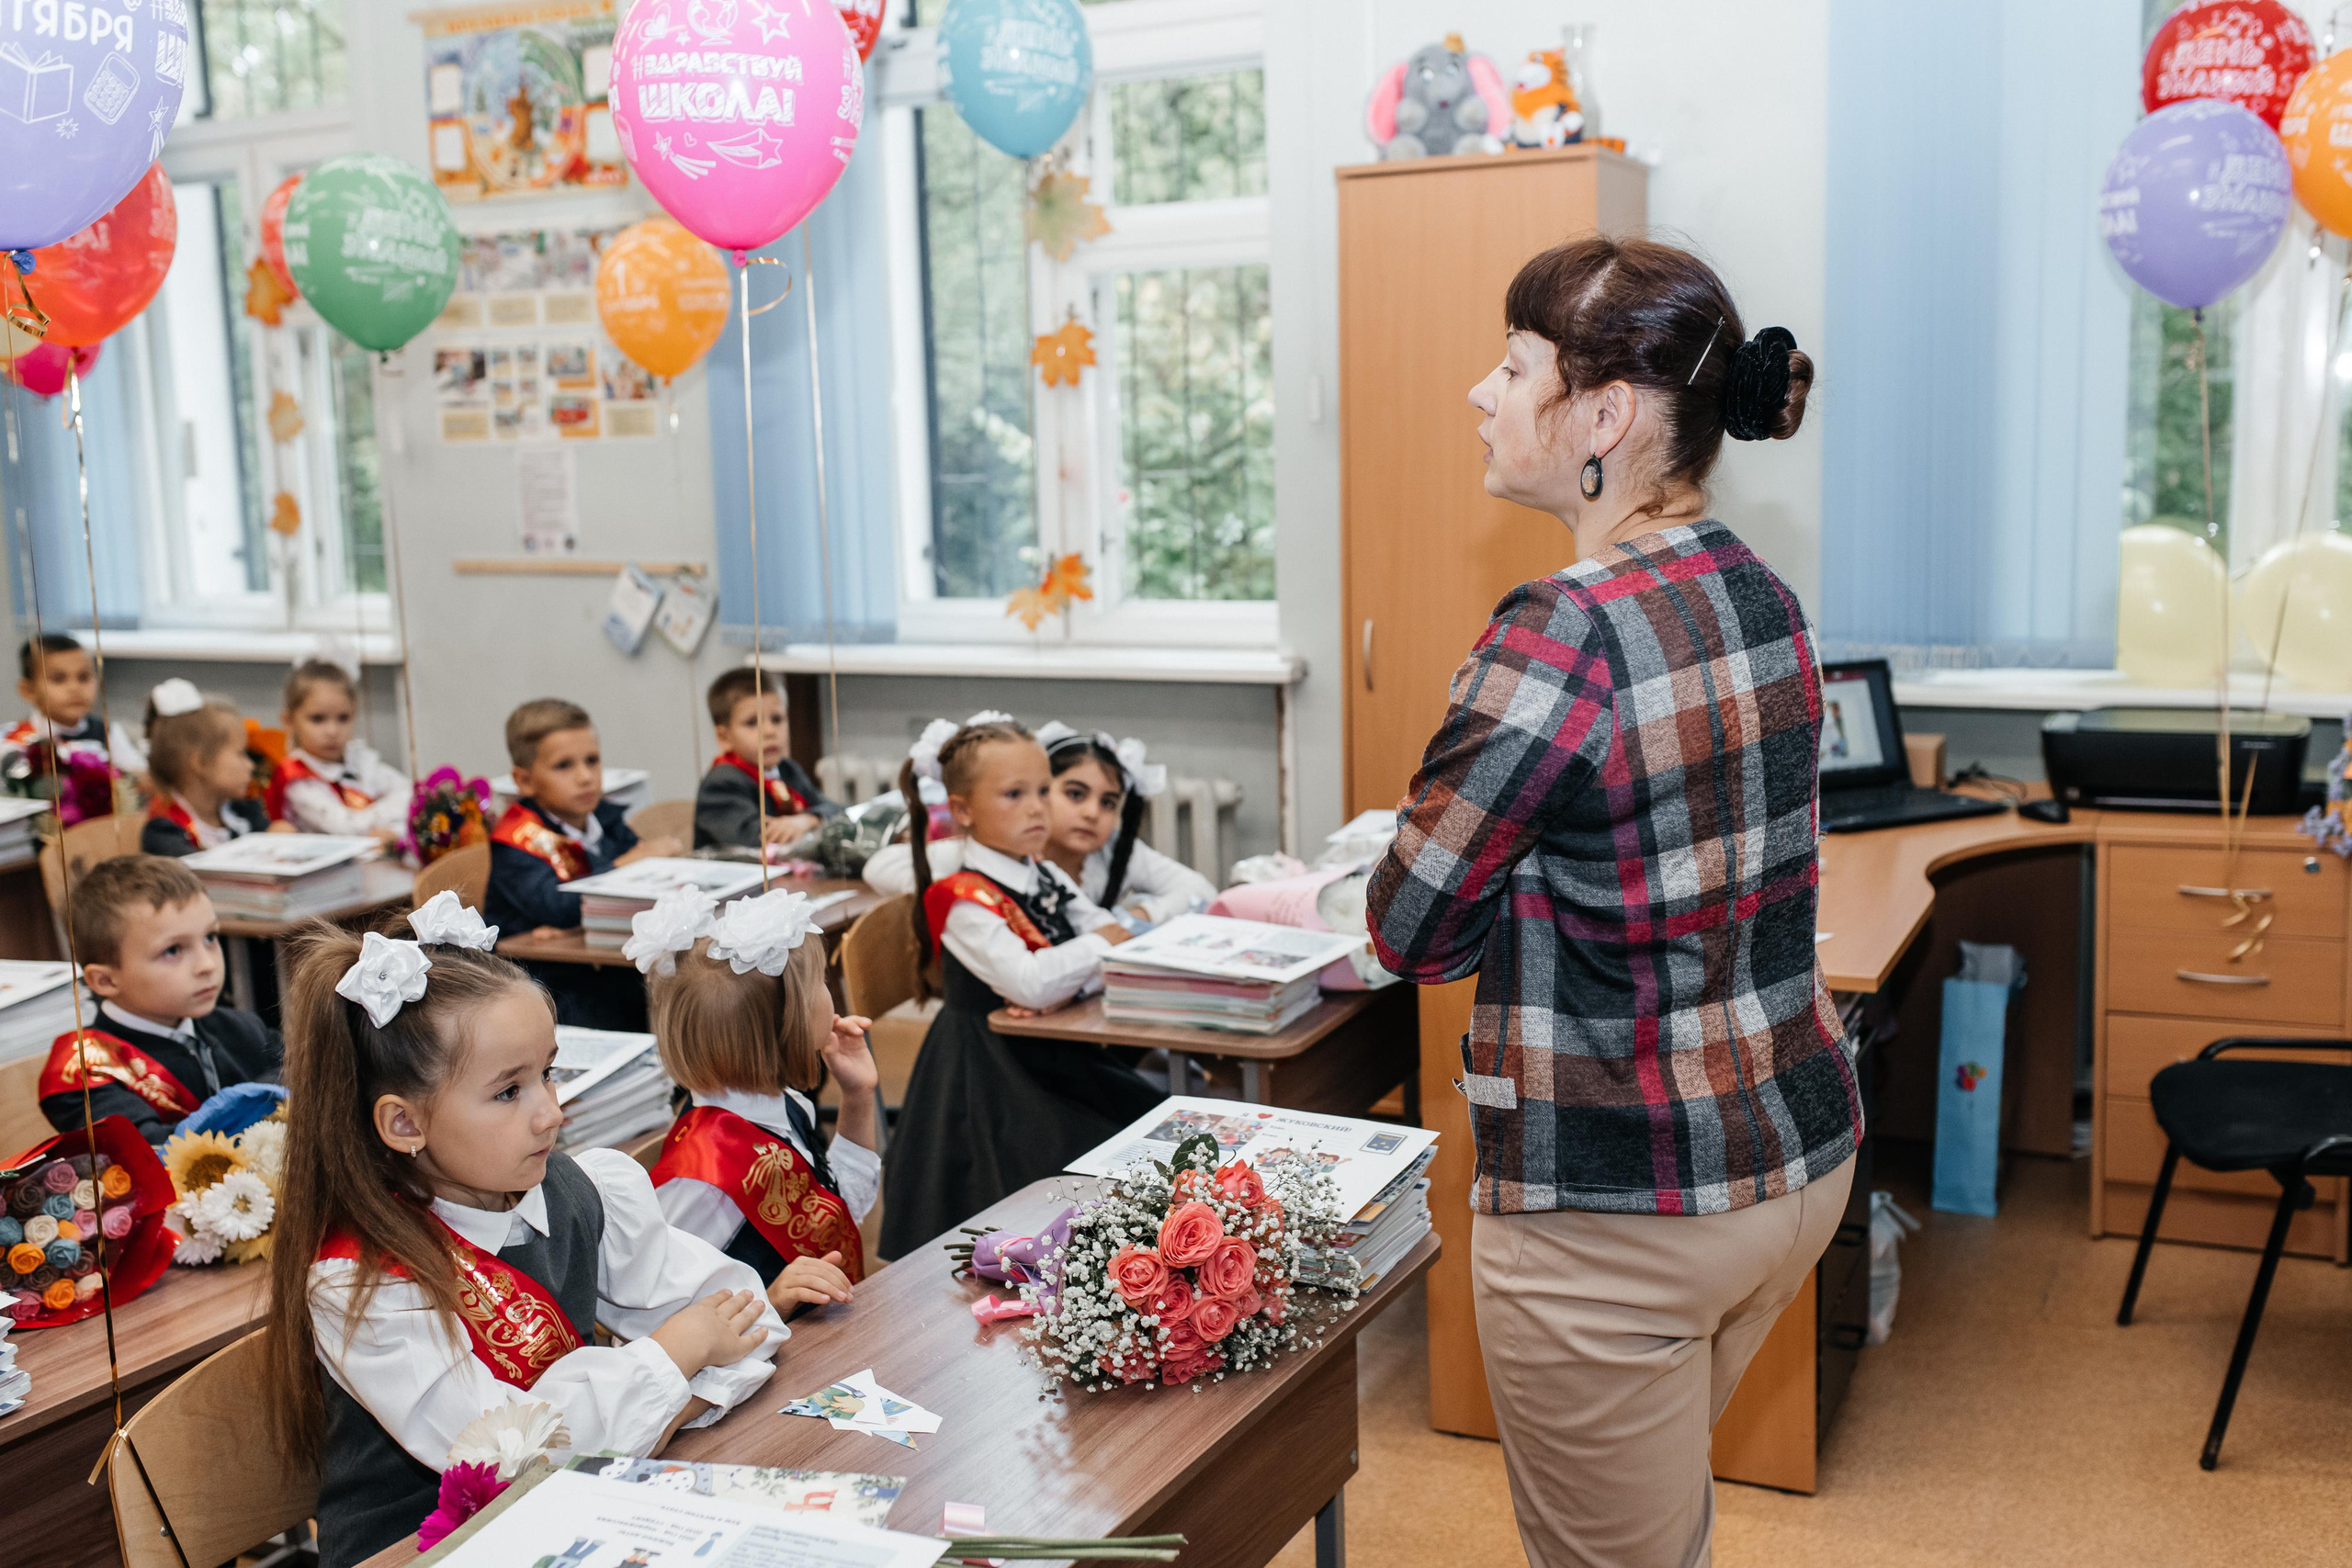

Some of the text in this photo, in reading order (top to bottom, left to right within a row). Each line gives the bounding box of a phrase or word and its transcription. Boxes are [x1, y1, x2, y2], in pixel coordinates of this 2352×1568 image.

[0, 0, 133, 53] ТЯБРЯ
[631, 51, 804, 85] #ЗДРАВСТВУЙ
[638, 82, 796, 127] ШКОЛА!
[1276, 1117, 1352, 1133] ЖУКОВСКИЙ!
